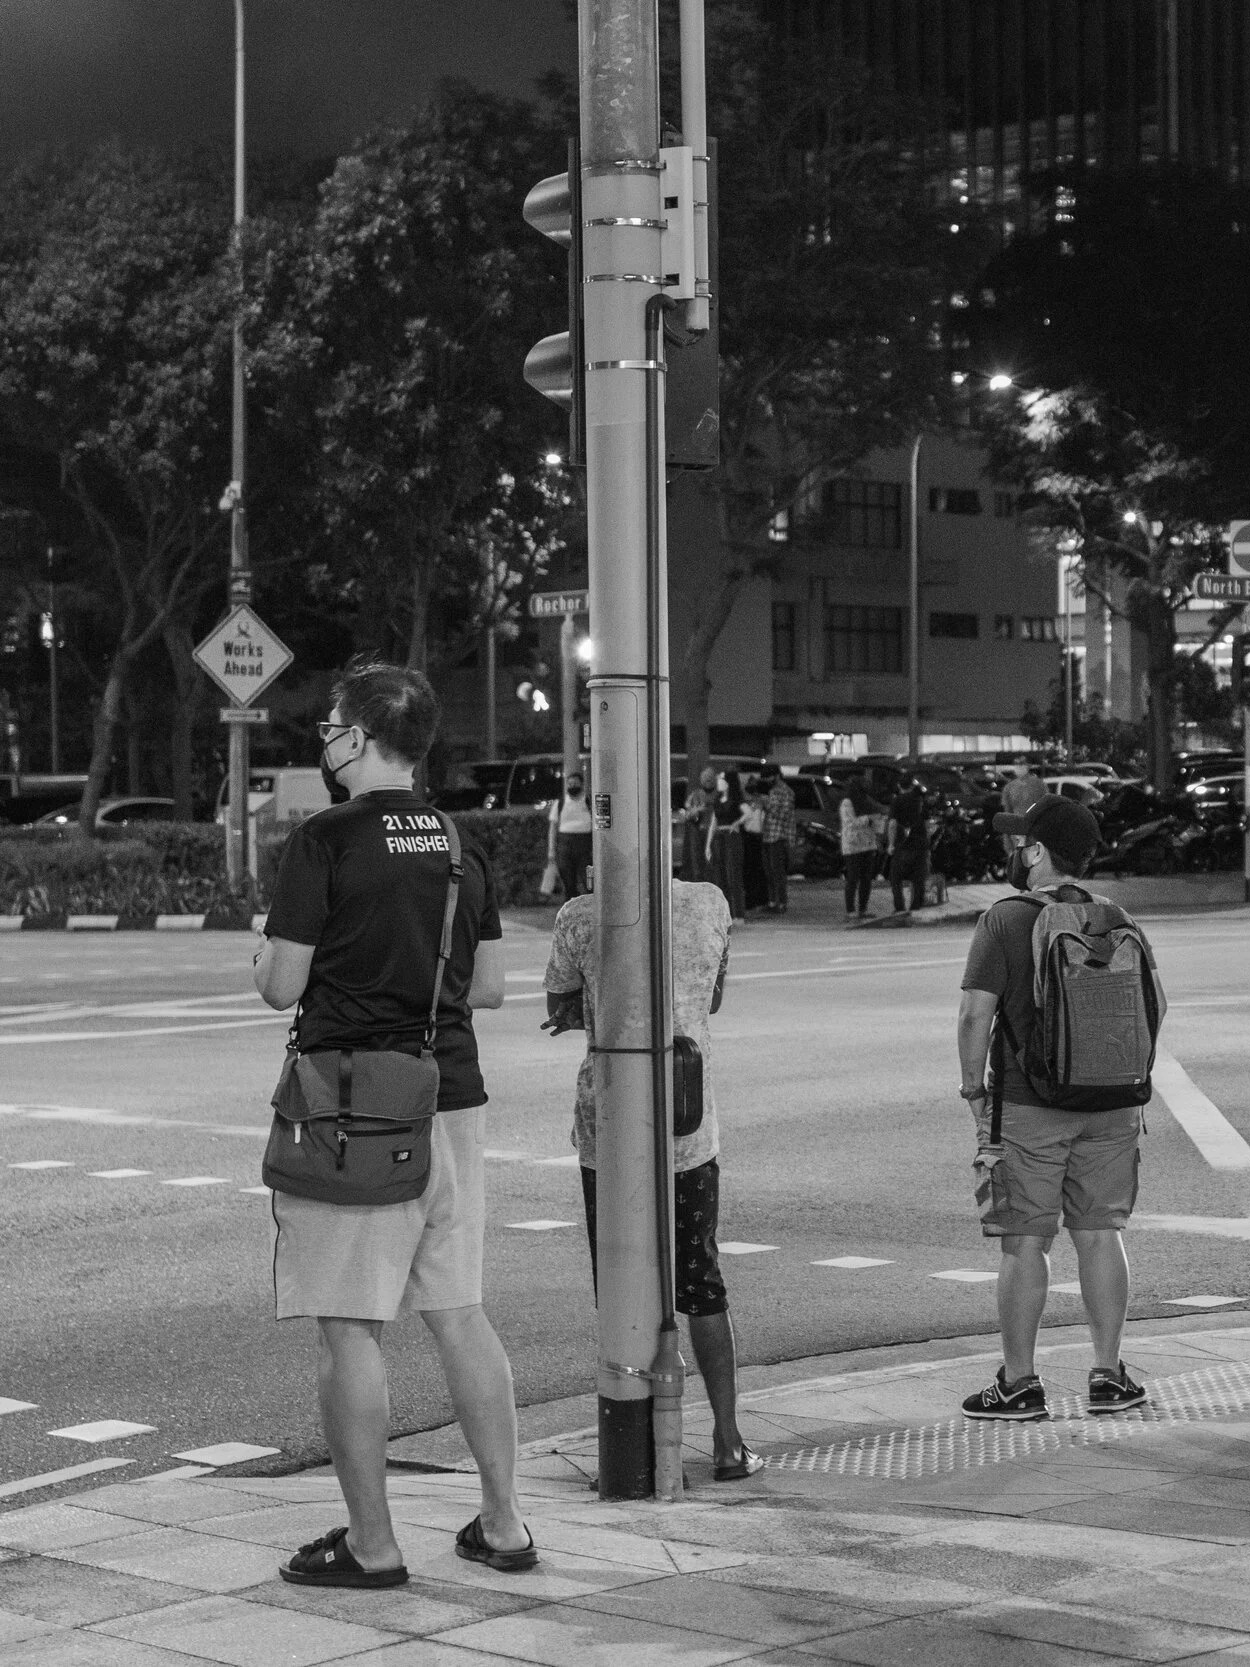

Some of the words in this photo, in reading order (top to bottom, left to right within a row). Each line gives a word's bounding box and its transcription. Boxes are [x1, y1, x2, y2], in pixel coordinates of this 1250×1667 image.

[1203, 578, 1241, 595] North
[535, 595, 580, 613] Rochor
[223, 641, 263, 658] Works
[223, 660, 263, 677] Ahead
[382, 814, 442, 830] 21.1KM
